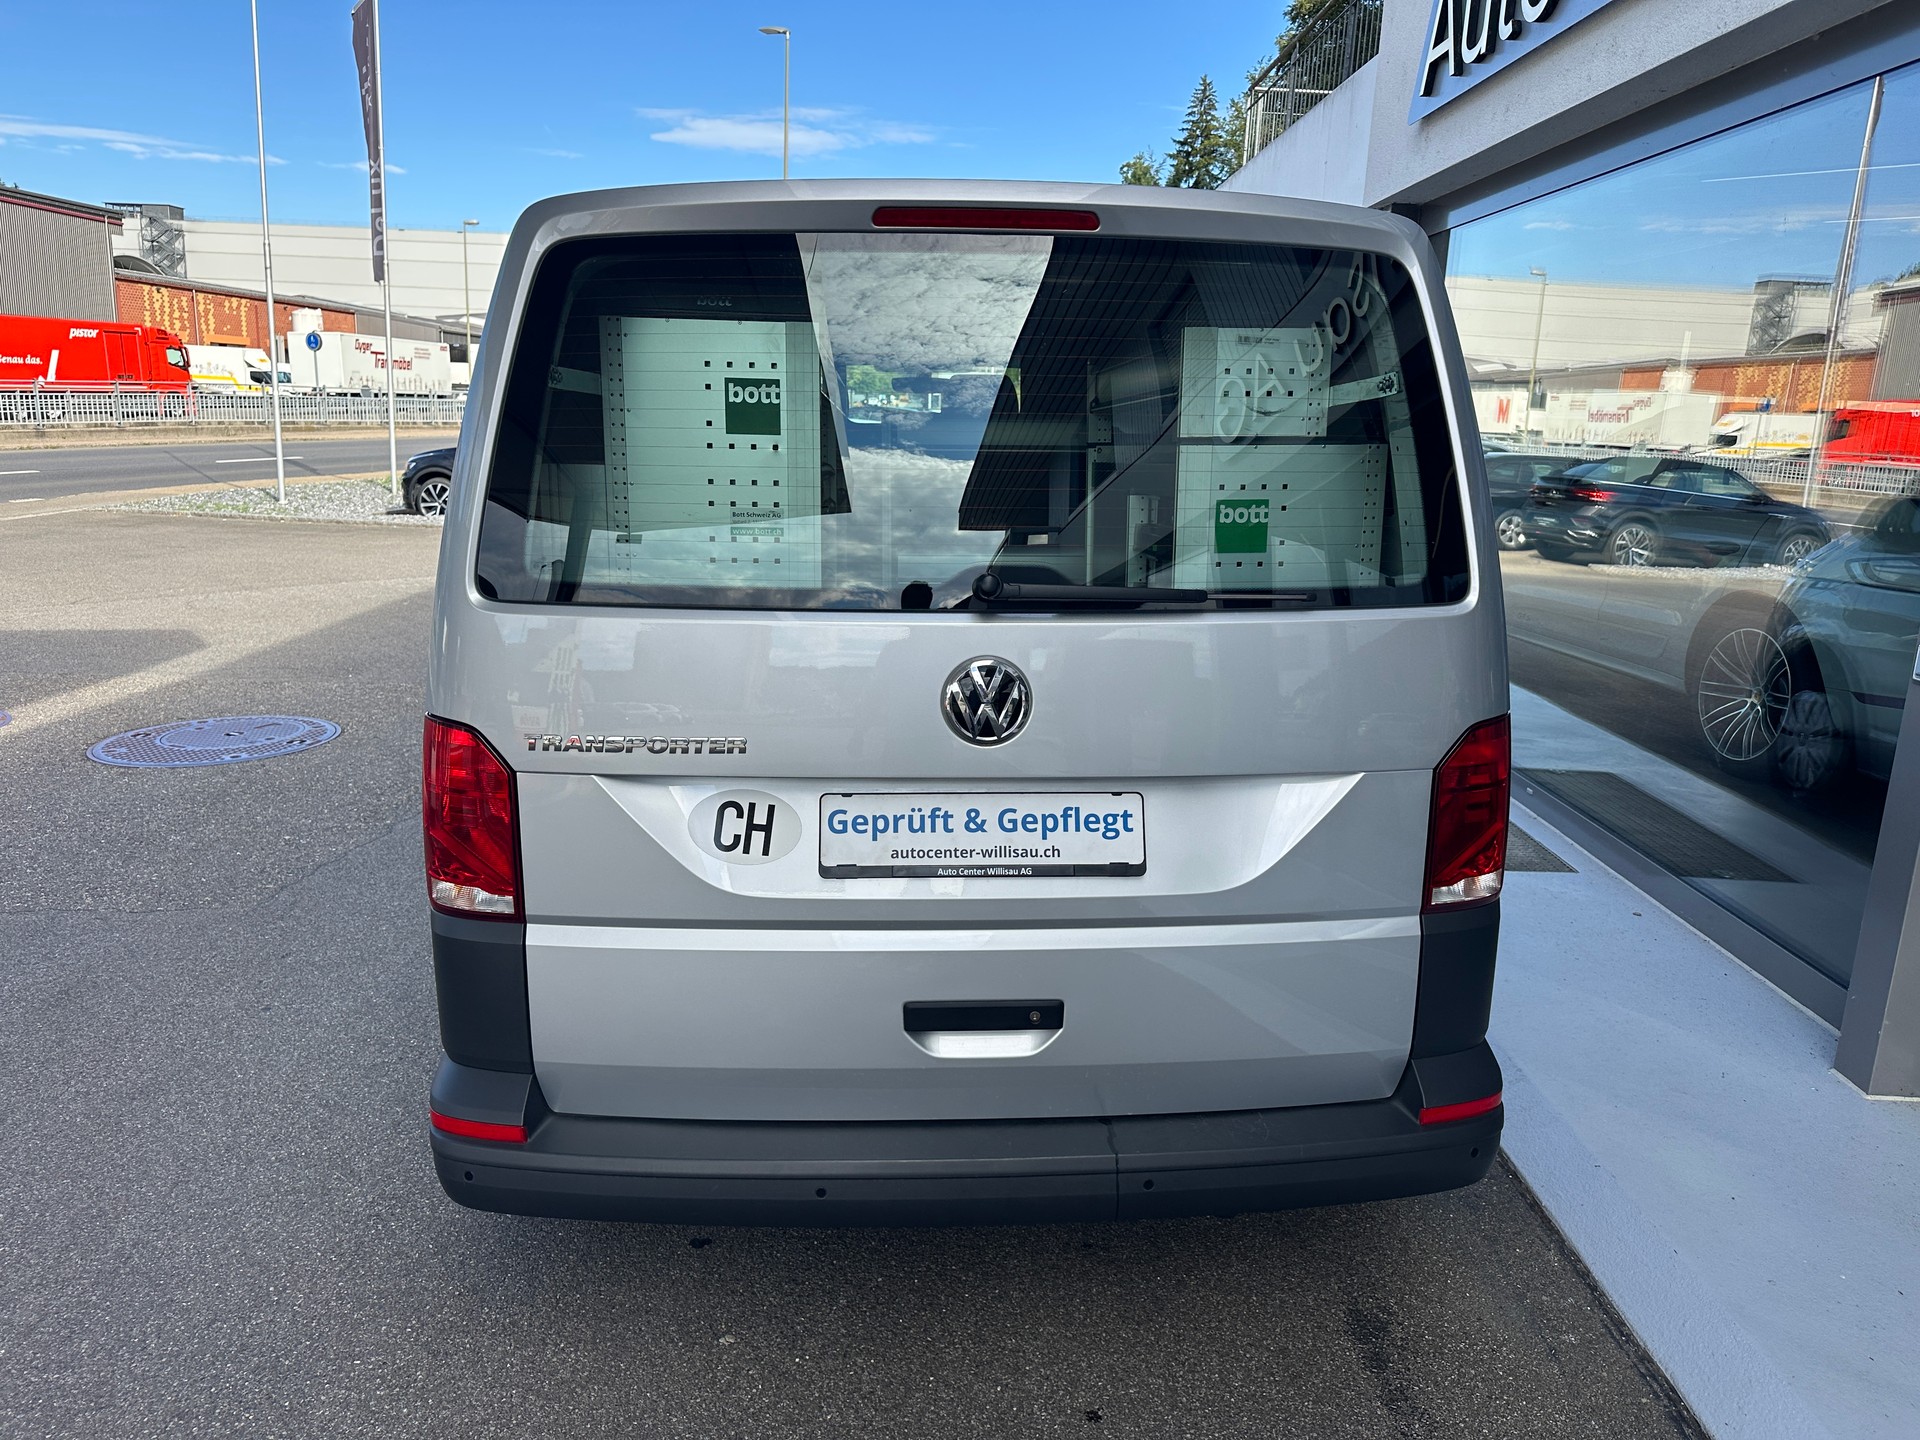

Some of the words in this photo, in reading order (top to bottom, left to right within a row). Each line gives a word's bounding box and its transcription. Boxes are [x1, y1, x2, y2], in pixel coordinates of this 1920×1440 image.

[69, 328, 99, 339] pistor
[25, 354, 43, 364] das.
[371, 351, 413, 370] Tranmöbel
[728, 383, 780, 404] bott
[1219, 504, 1269, 524] bott
[523, 733, 748, 755] TRANSPORTER
[713, 800, 776, 857] CH
[827, 806, 955, 841] Geprüft
[963, 807, 989, 833] &
[997, 806, 1134, 840] Gepflegt
[890, 844, 1061, 859] autocenter-willisau.ch
[937, 866, 957, 876] Auto
[958, 866, 985, 876] Center
[986, 866, 1018, 876] Willisau
[1019, 866, 1033, 876] AG
